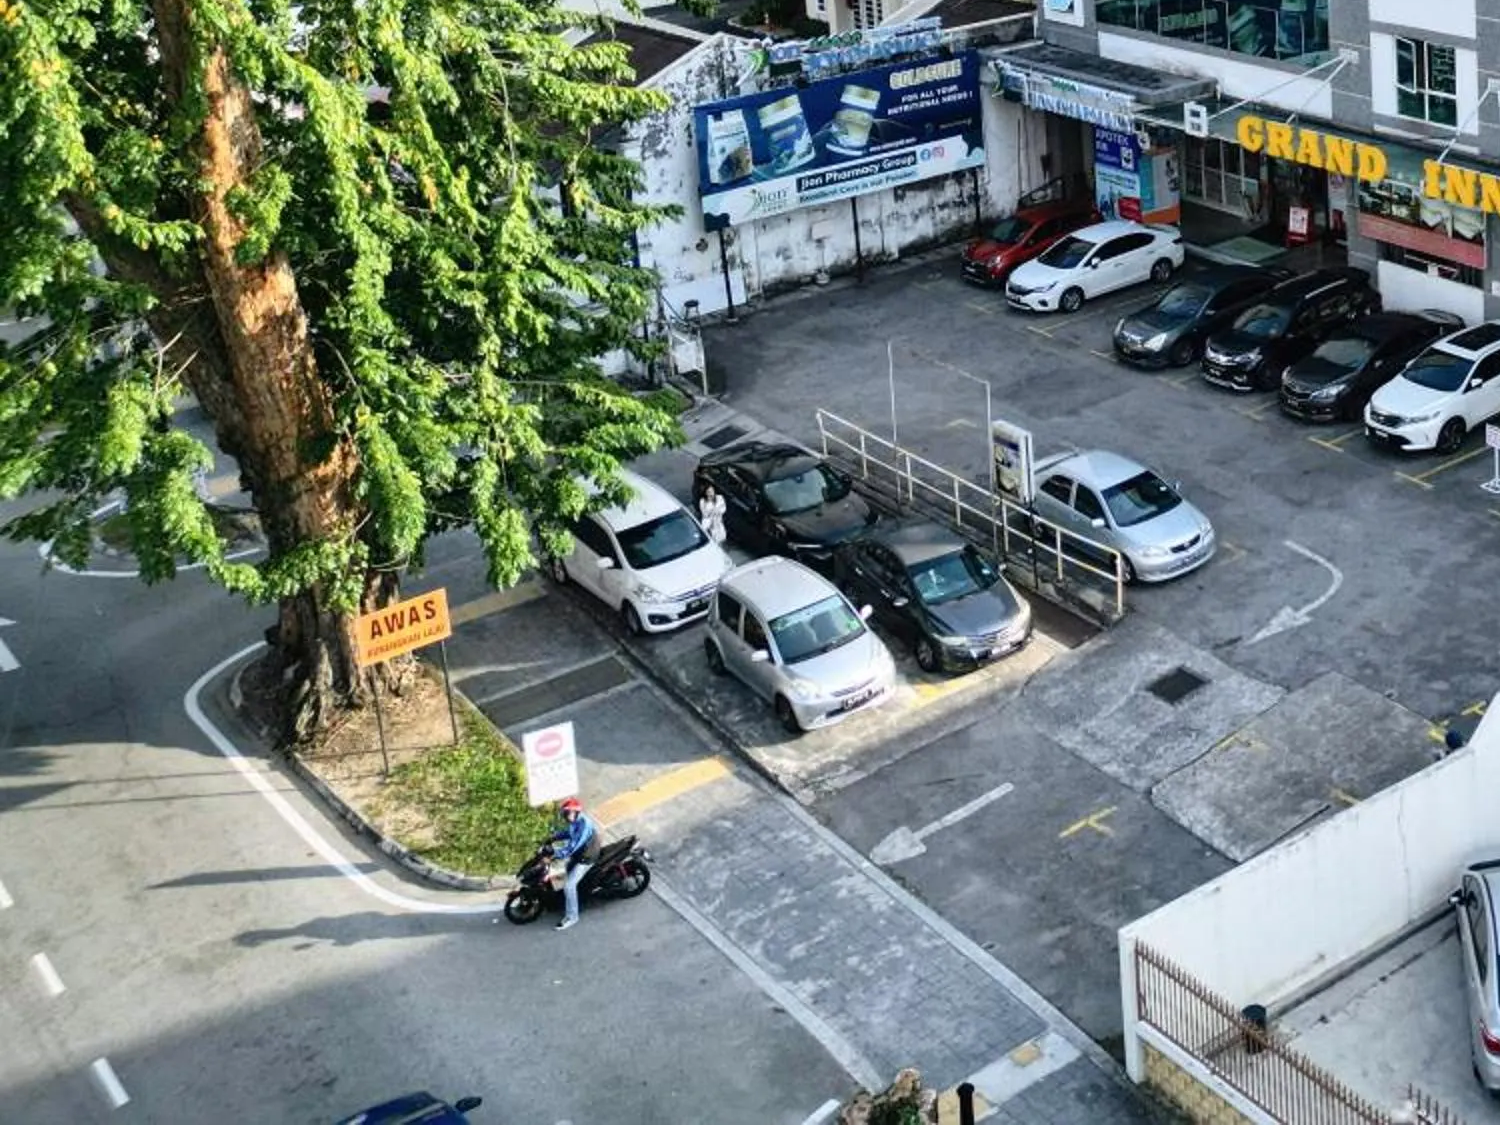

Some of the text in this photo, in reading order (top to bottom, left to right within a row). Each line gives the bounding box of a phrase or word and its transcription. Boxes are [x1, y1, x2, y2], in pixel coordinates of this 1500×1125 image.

[920, 90, 934, 99] ALL
[1238, 115, 1387, 182] GRAND
[825, 165, 879, 183] Pharmacy
[882, 154, 915, 169] Group
[370, 599, 436, 639] AWAS
